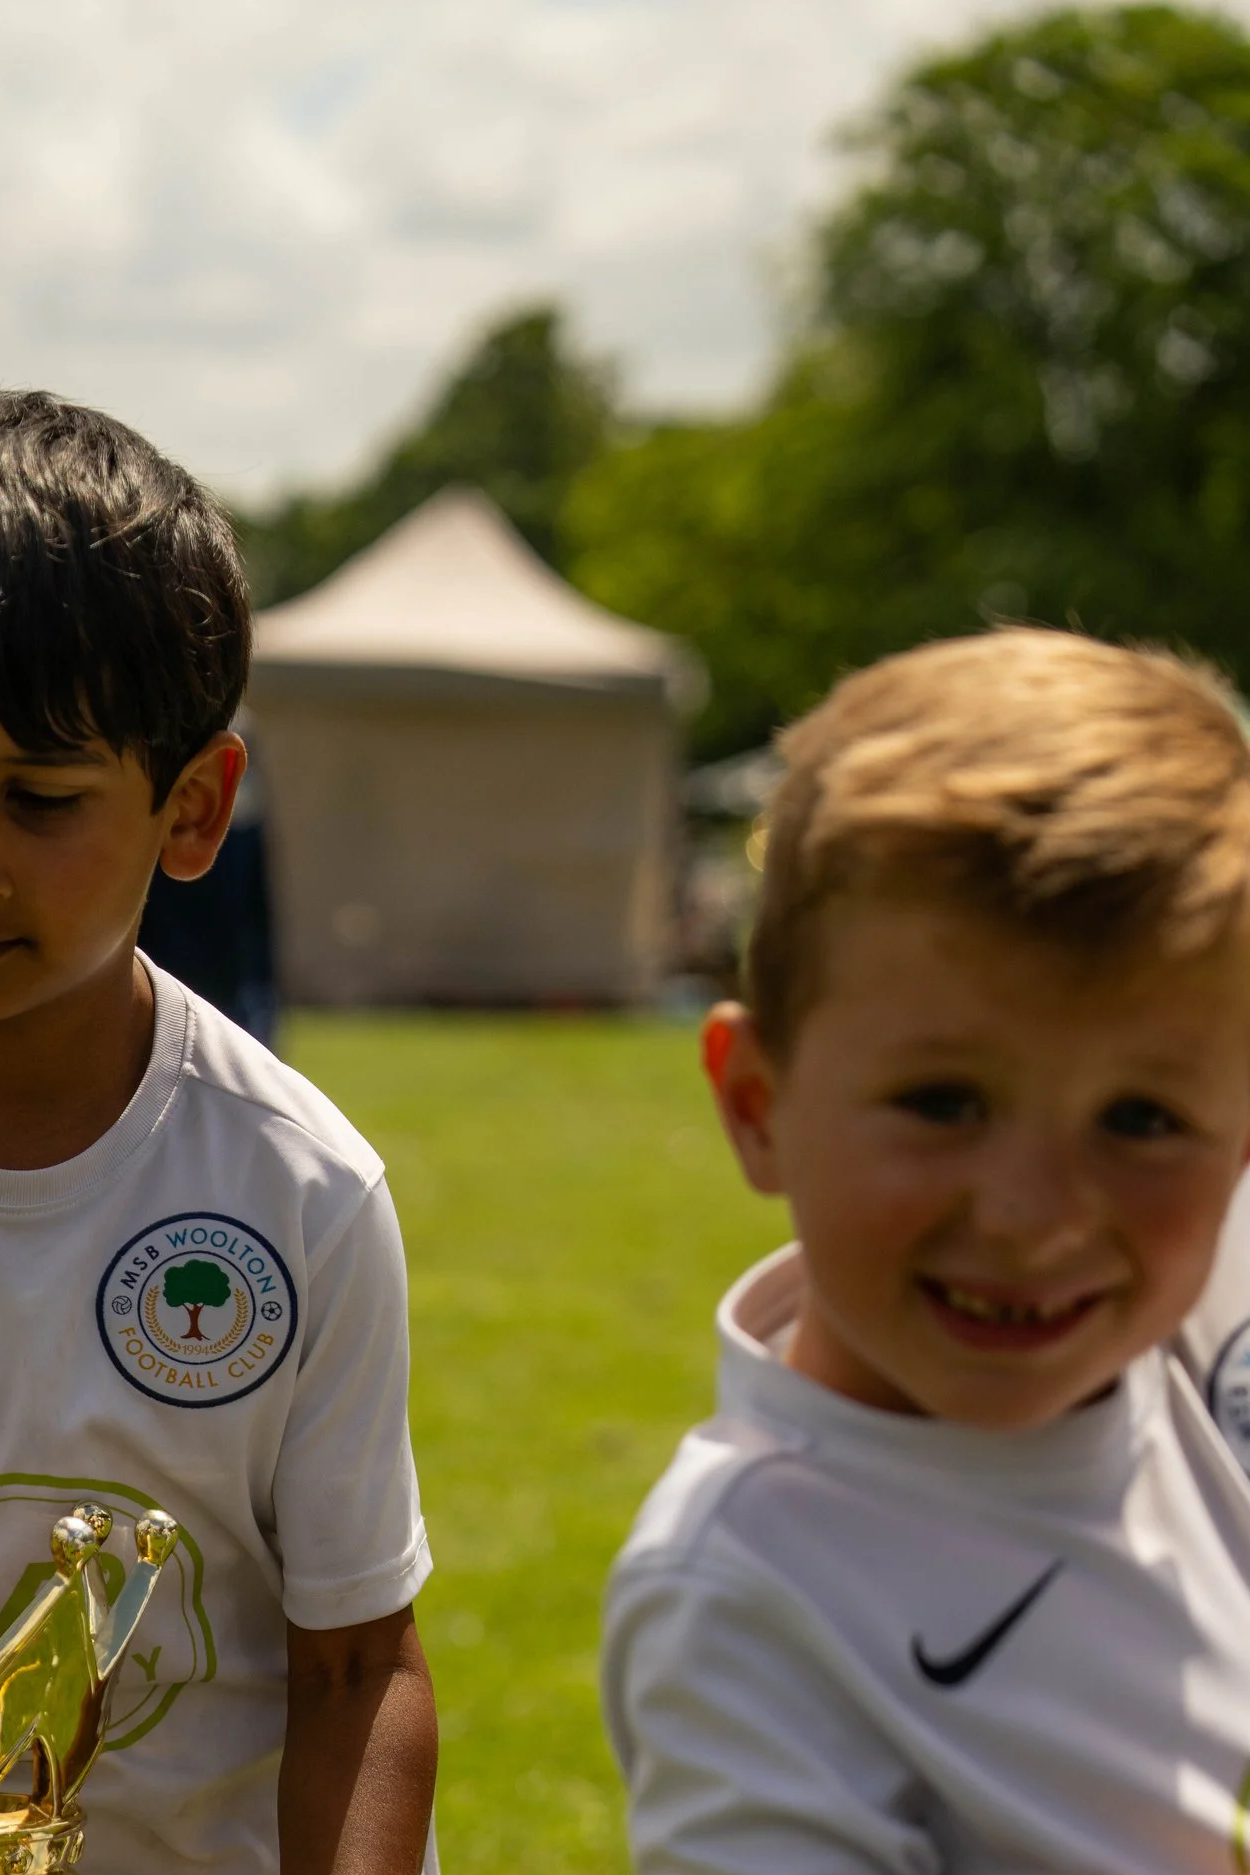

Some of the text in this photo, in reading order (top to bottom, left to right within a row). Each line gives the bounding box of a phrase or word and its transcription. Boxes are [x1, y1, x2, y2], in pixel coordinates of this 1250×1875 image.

[120, 1227, 276, 1294] MSB WOOLTON
[118, 1327, 275, 1389] FOOTBALL CLUB
[181, 1343, 210, 1356] 1994
